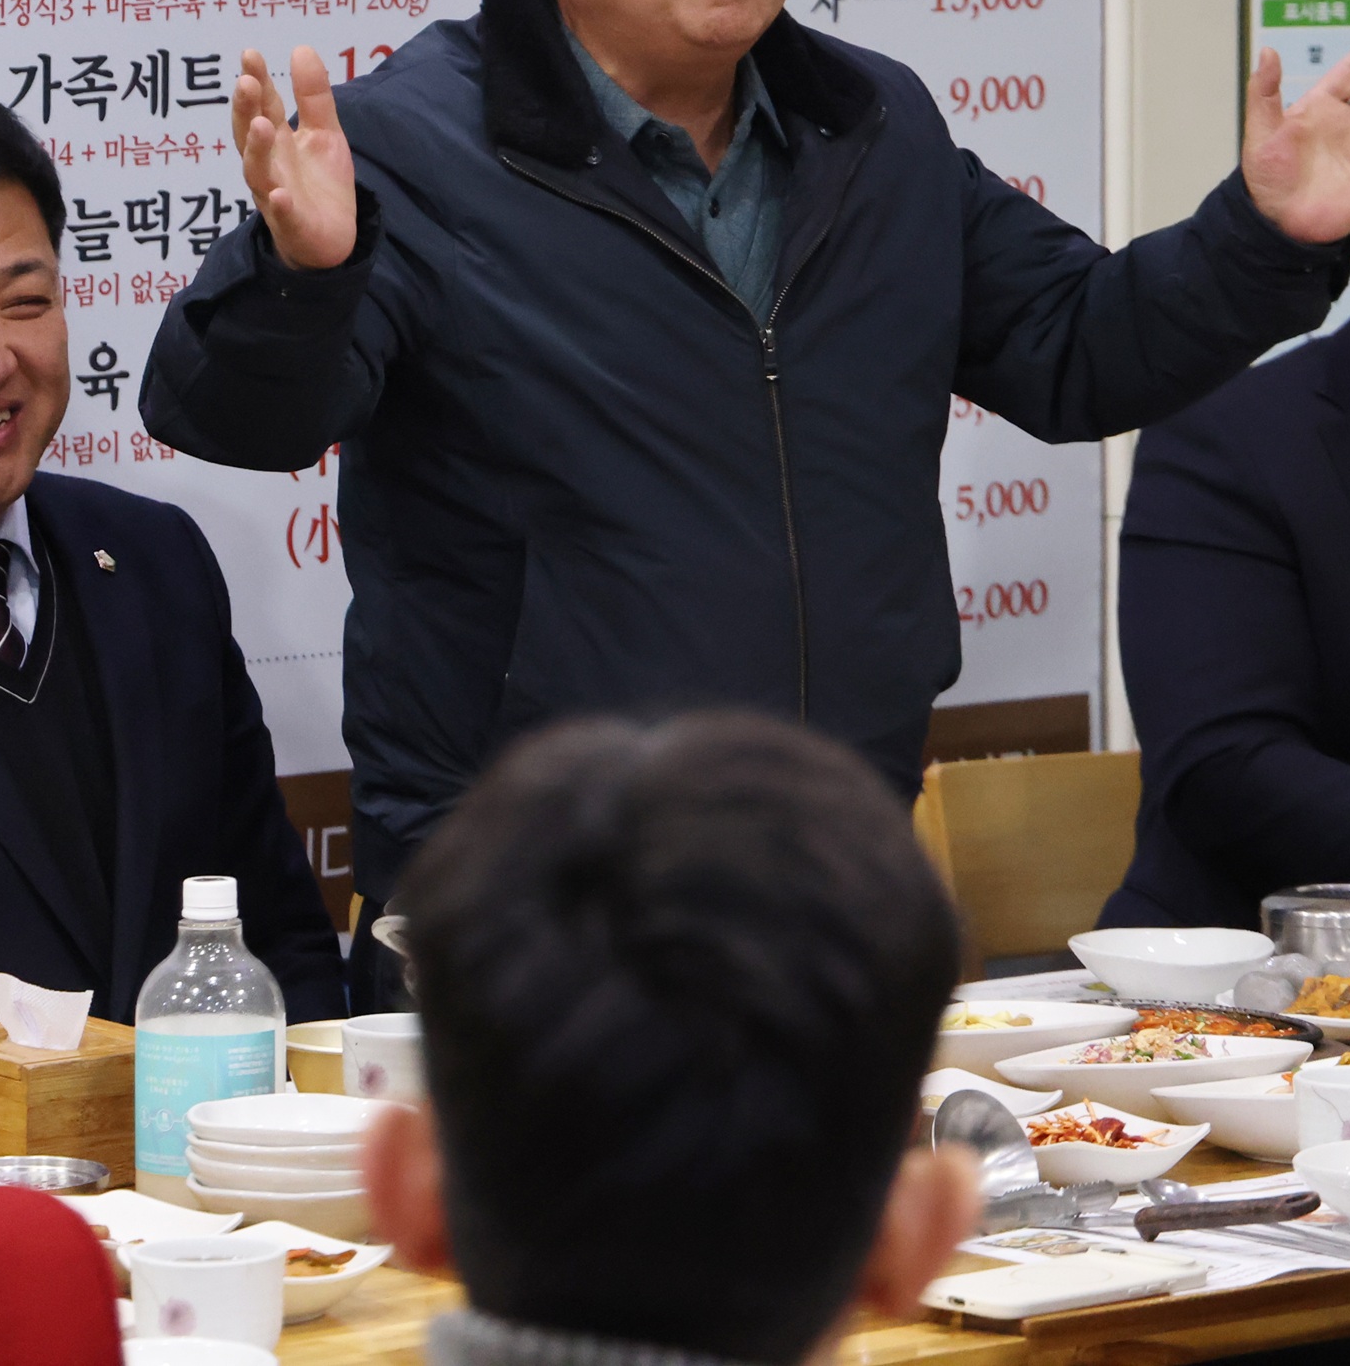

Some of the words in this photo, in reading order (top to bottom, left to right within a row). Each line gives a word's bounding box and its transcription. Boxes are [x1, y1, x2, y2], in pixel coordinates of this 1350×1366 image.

[8, 49, 229, 125] 가족세트
[949, 74, 1045, 120] 9,000
[104, 132, 204, 168] 마늘수육
[76, 341, 130, 411] 육
[956, 477, 1049, 527] 5,000
[957, 579, 1049, 627] 2,000
